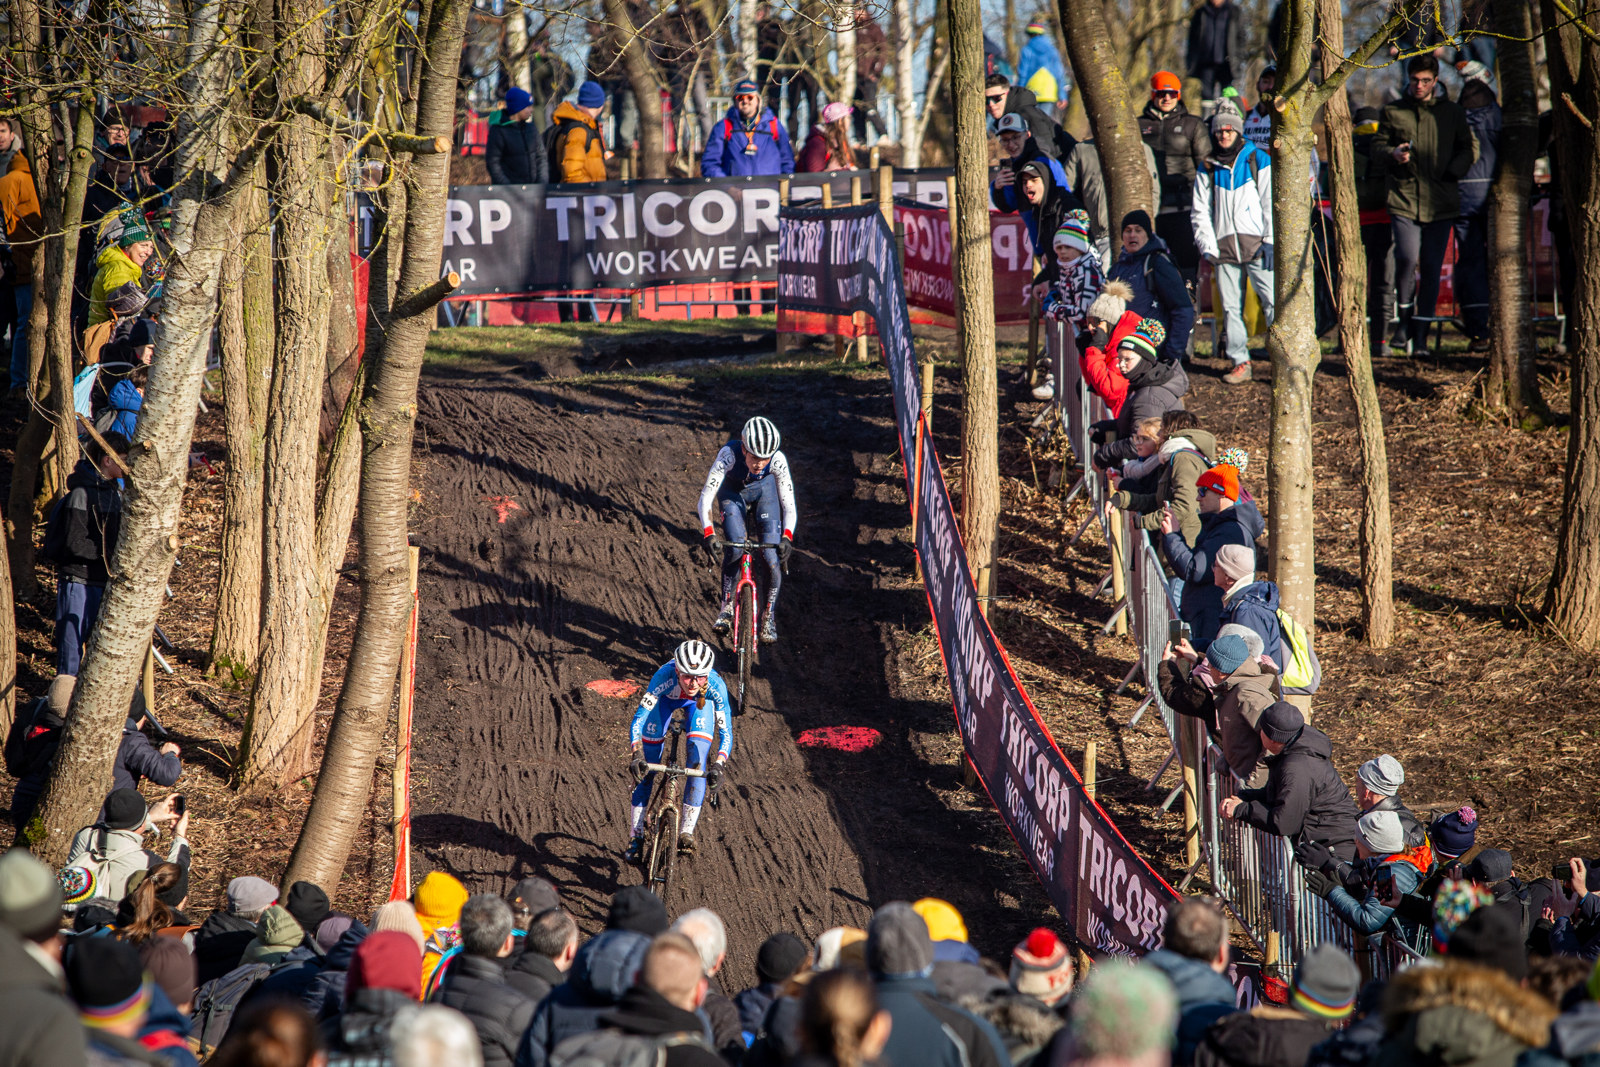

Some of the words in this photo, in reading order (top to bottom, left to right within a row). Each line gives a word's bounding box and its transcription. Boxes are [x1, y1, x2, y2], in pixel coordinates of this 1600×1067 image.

[546, 187, 781, 241] TRICOR
[779, 217, 825, 264] RICORP
[586, 245, 779, 276] WORKWEAR
[952, 550, 995, 709] TRICORP
[1000, 698, 1070, 843] TRICORP
[1005, 772, 1055, 881] WORKWEAR
